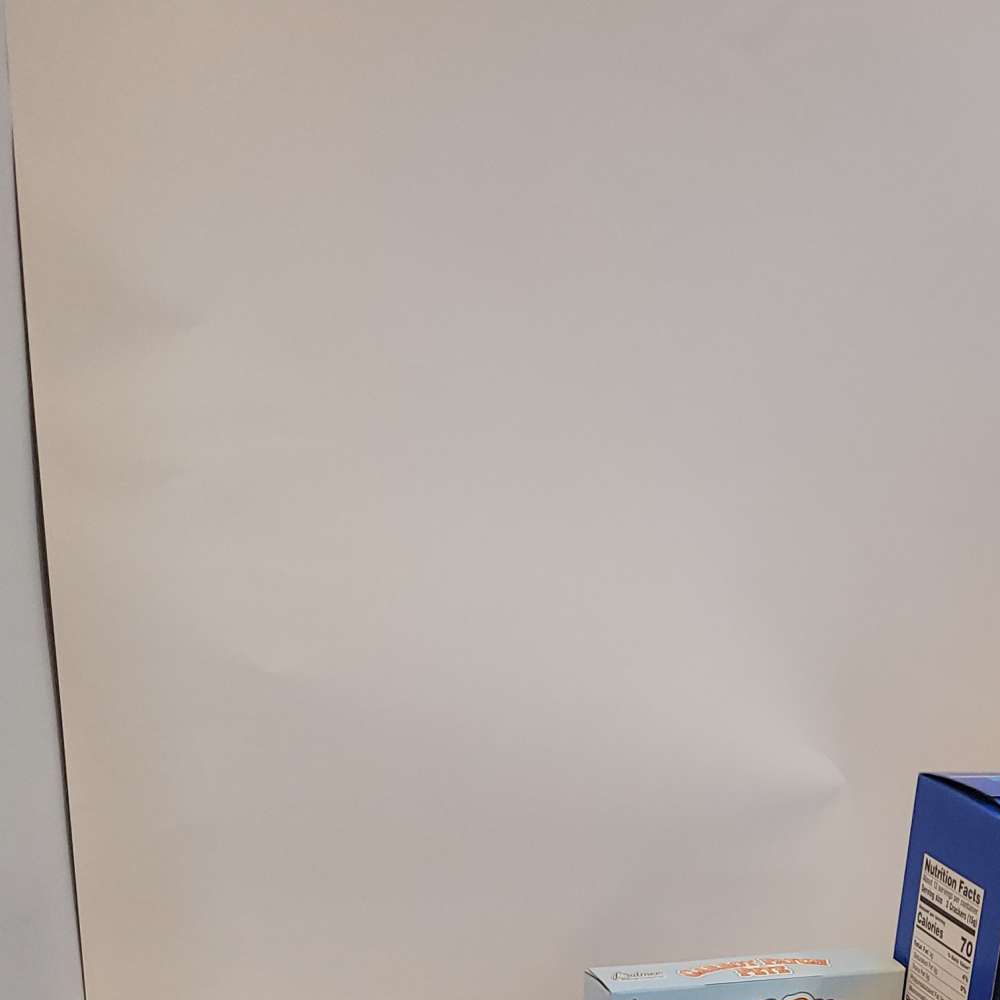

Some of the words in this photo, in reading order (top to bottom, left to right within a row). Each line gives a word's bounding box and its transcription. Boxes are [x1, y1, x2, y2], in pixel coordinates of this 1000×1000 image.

[924, 857, 957, 891] Nutrition
[958, 881, 981, 905] Facts
[917, 911, 944, 940] Calories
[960, 936, 974, 958] 70
